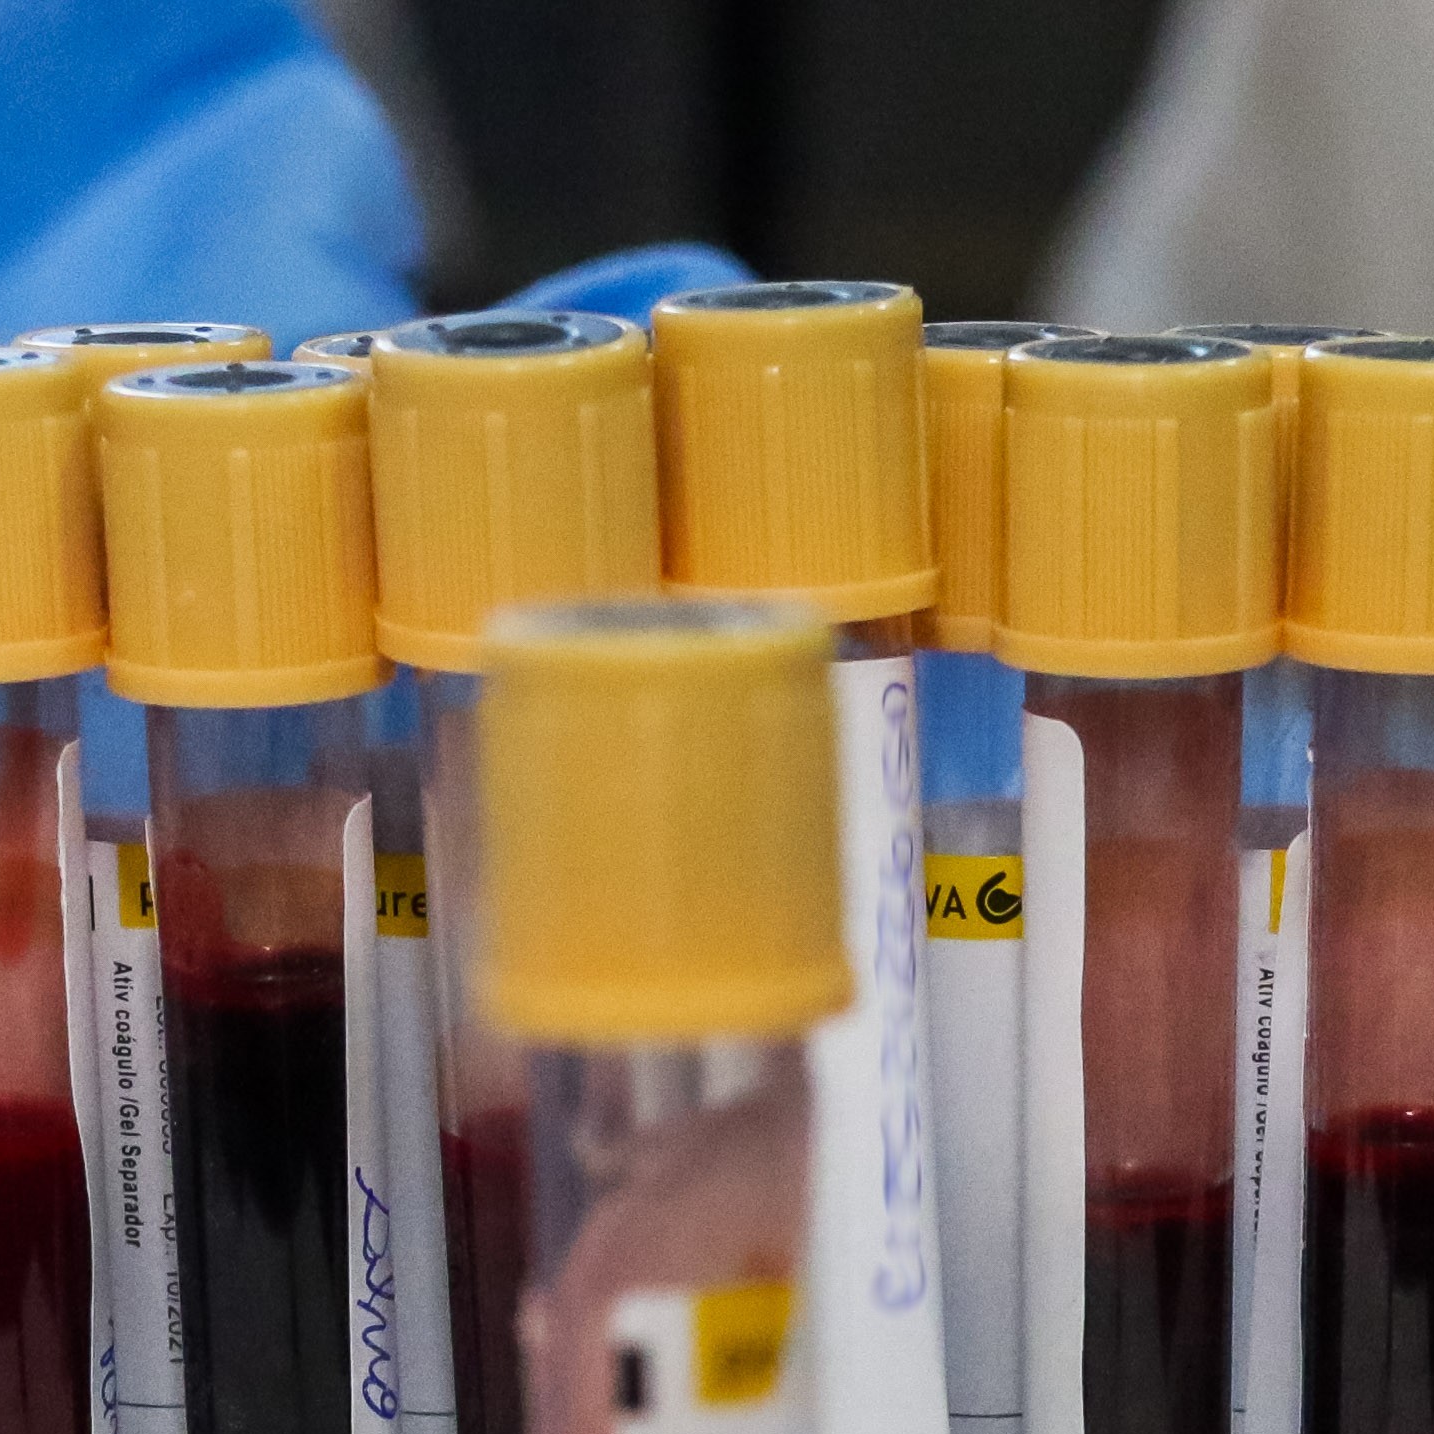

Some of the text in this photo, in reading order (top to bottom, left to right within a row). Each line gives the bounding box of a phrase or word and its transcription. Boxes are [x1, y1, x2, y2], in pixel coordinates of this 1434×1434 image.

[112, 961, 146, 1249] Ativ coágulo /Gel Separador
